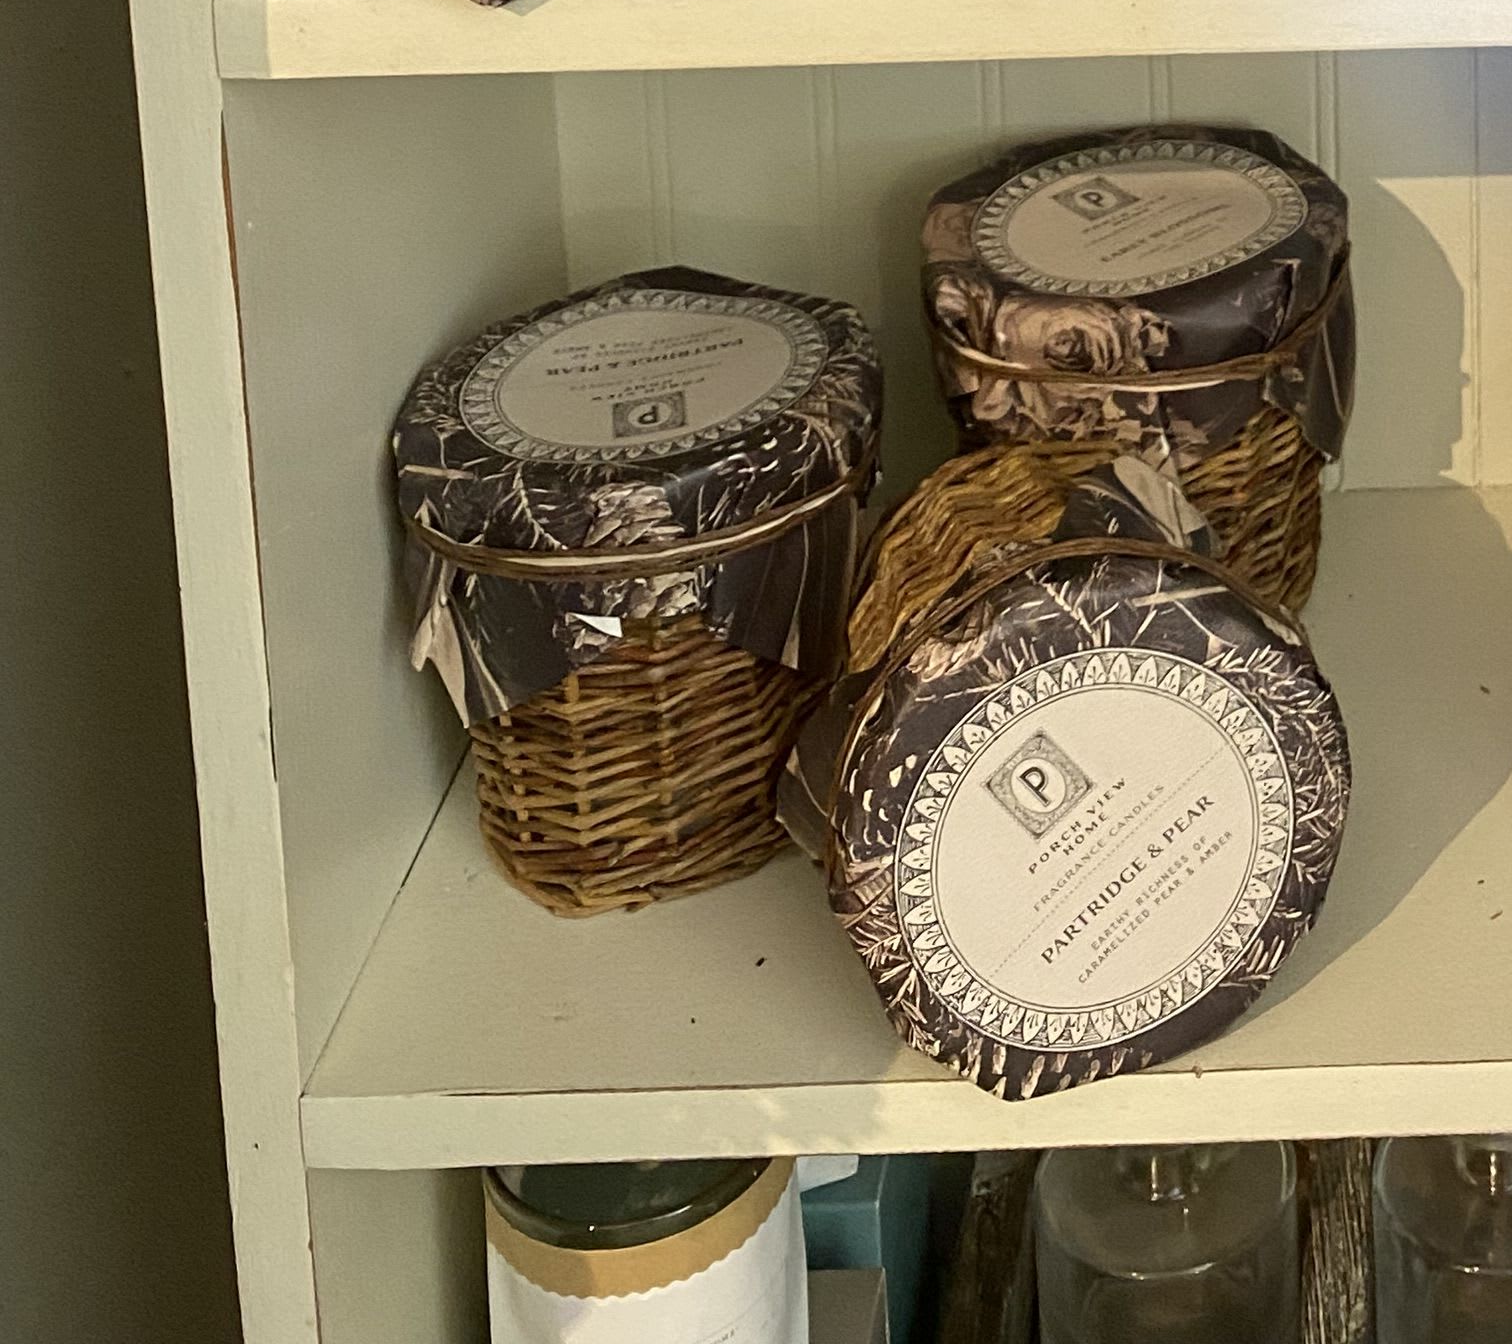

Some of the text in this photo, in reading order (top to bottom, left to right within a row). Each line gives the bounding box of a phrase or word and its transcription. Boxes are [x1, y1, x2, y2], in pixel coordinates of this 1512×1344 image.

[1018, 766, 1050, 807] P
[1027, 777, 1127, 875] PORCH VIEW
[1062, 811, 1109, 856] HOME
[1040, 794, 1215, 964] PARTRIDGE & PEAR
